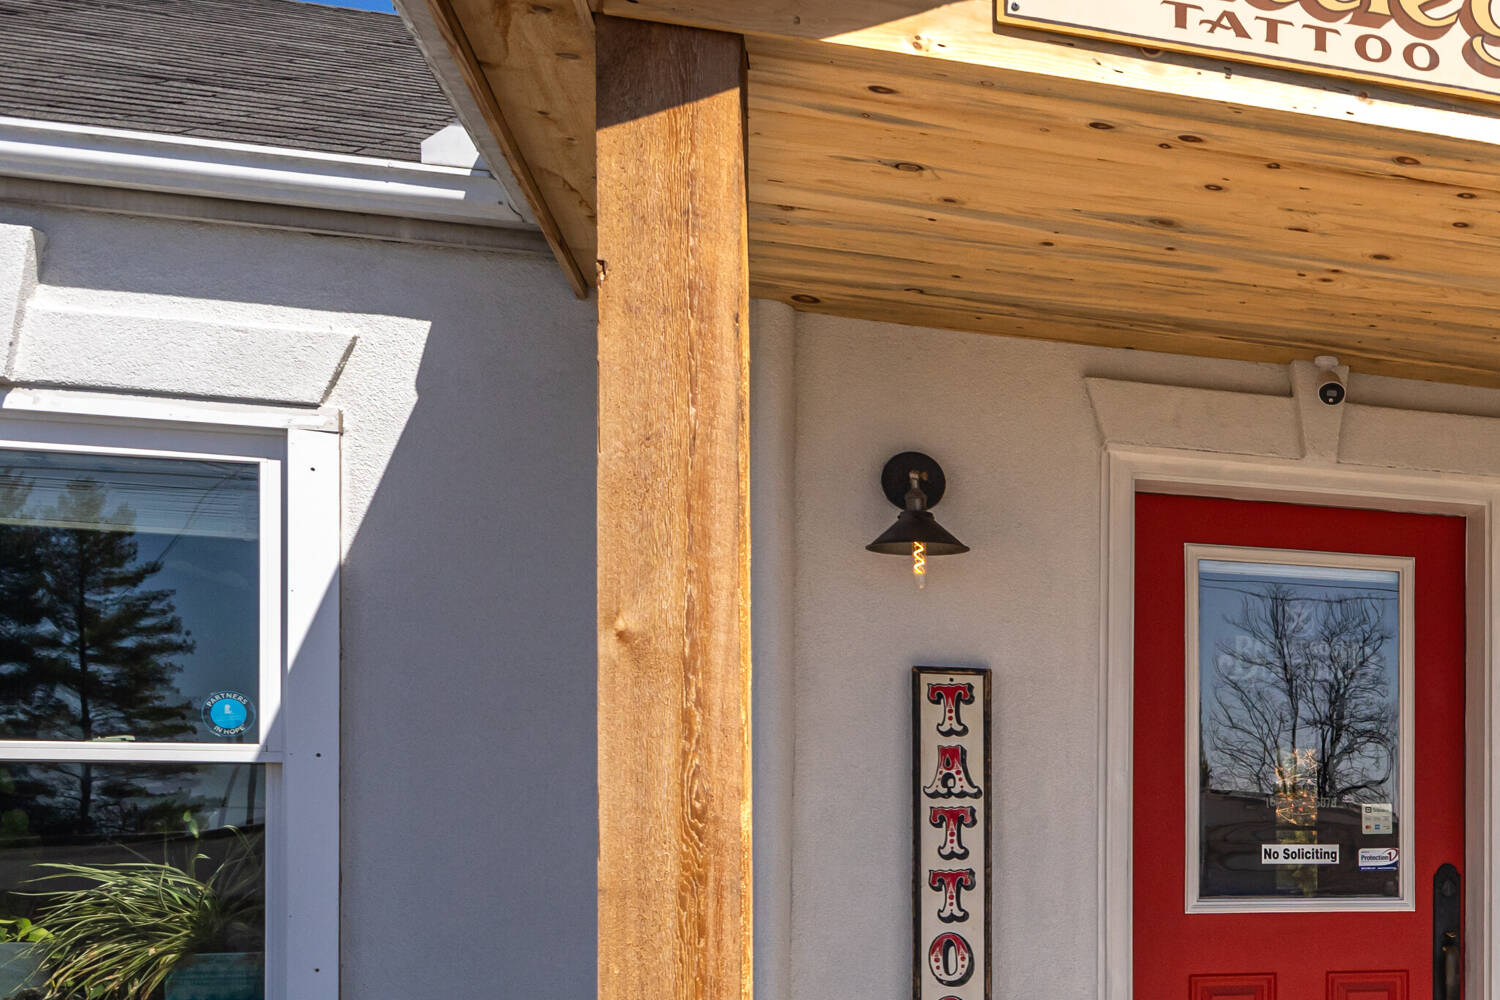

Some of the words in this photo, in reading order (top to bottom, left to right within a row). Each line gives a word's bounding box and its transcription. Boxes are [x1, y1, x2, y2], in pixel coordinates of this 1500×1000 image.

[1161, 0, 1441, 72] TATTOO
[206, 693, 248, 707] PARTNERS
[1263, 848, 1280, 860] No
[1283, 848, 1338, 863] Soliciting
